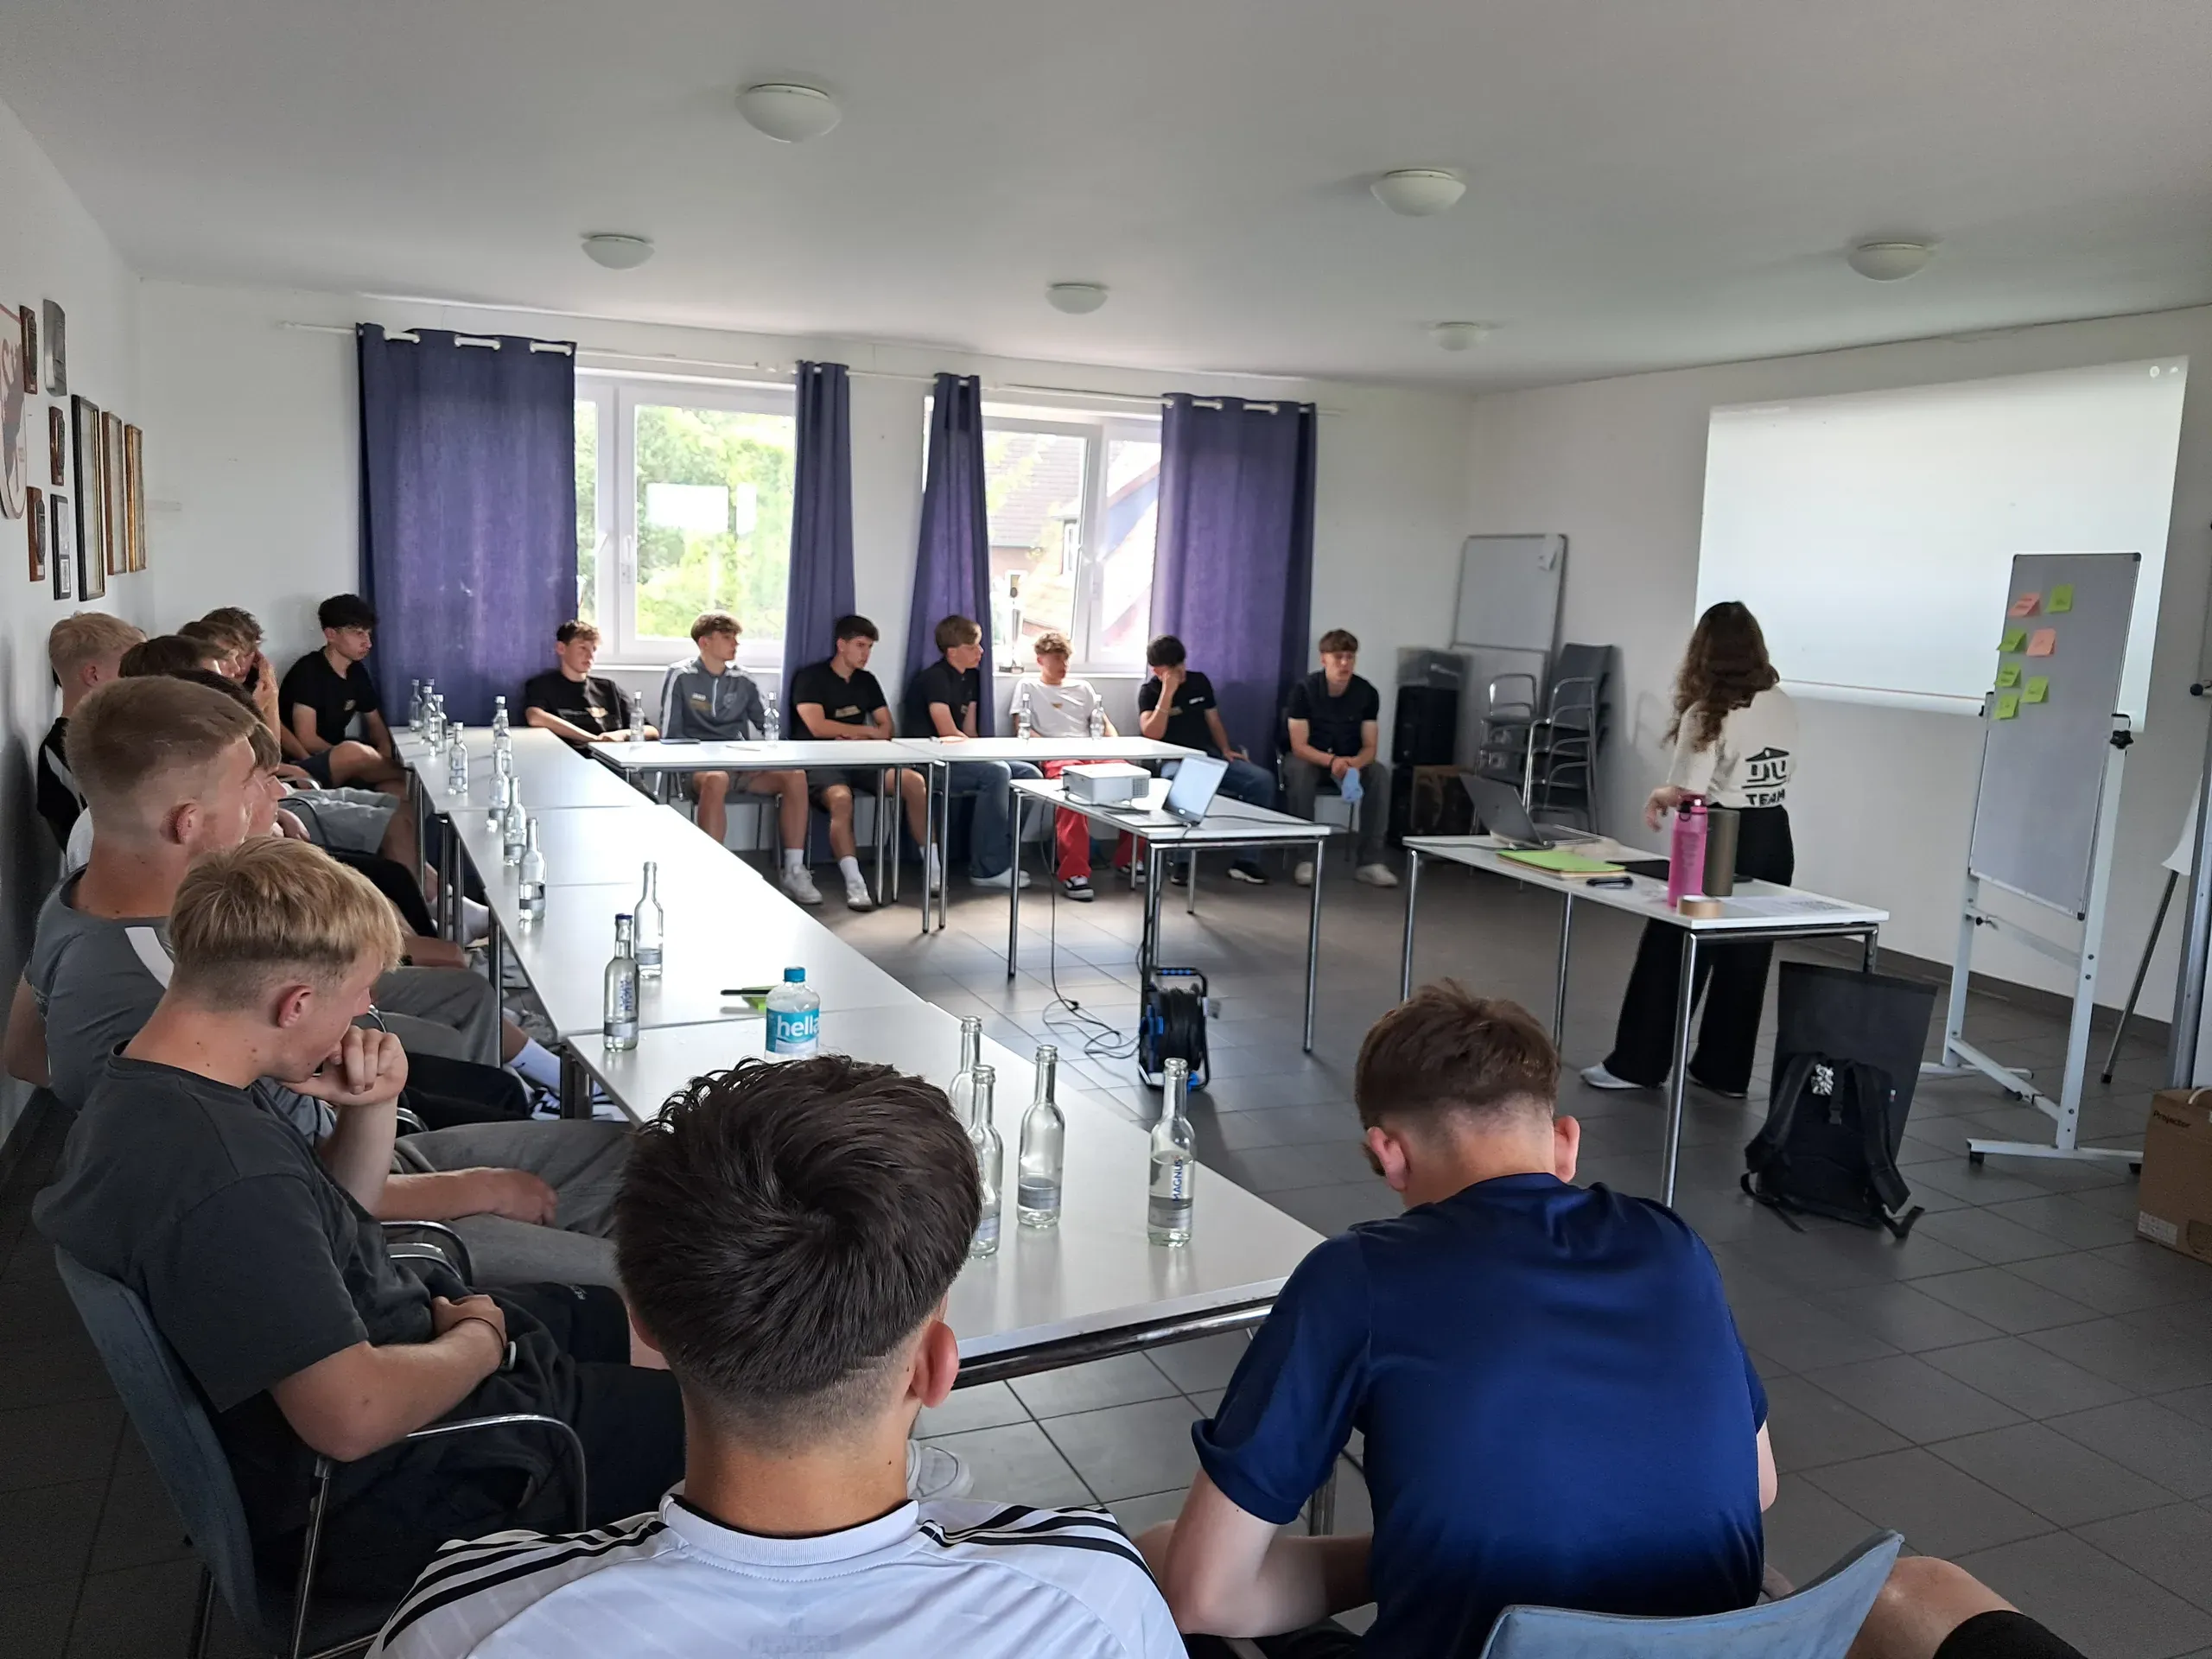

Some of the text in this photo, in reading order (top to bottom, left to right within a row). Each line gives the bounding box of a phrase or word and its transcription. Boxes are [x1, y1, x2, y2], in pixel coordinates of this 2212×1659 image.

[1745, 789, 1786, 806] TEAM
[2152, 1109, 2192, 1129] Projector
[1171, 1158, 1184, 1202] MAGNUS
